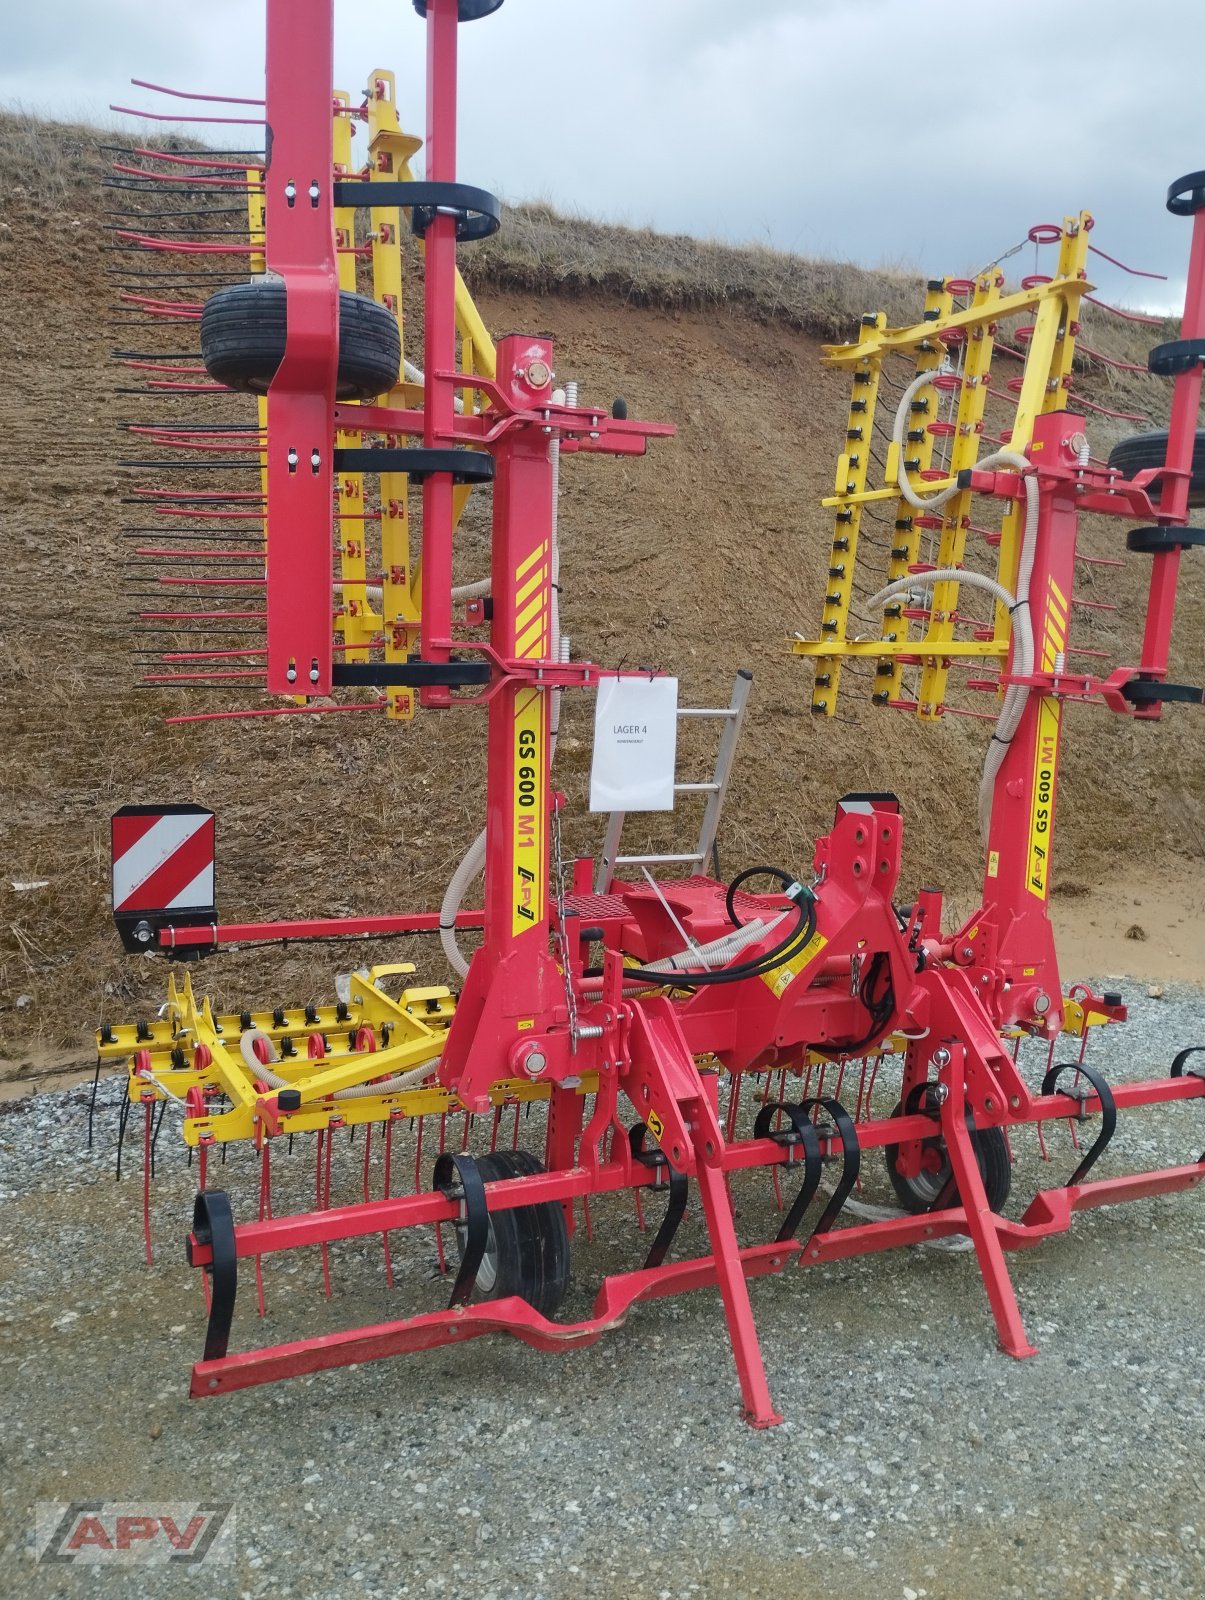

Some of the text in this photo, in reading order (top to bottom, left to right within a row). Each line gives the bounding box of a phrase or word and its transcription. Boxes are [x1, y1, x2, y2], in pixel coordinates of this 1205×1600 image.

[613, 725, 647, 734] LAGER 4
[517, 729, 536, 848] GS 600 M1
[1036, 736, 1054, 833] GS 600 M1
